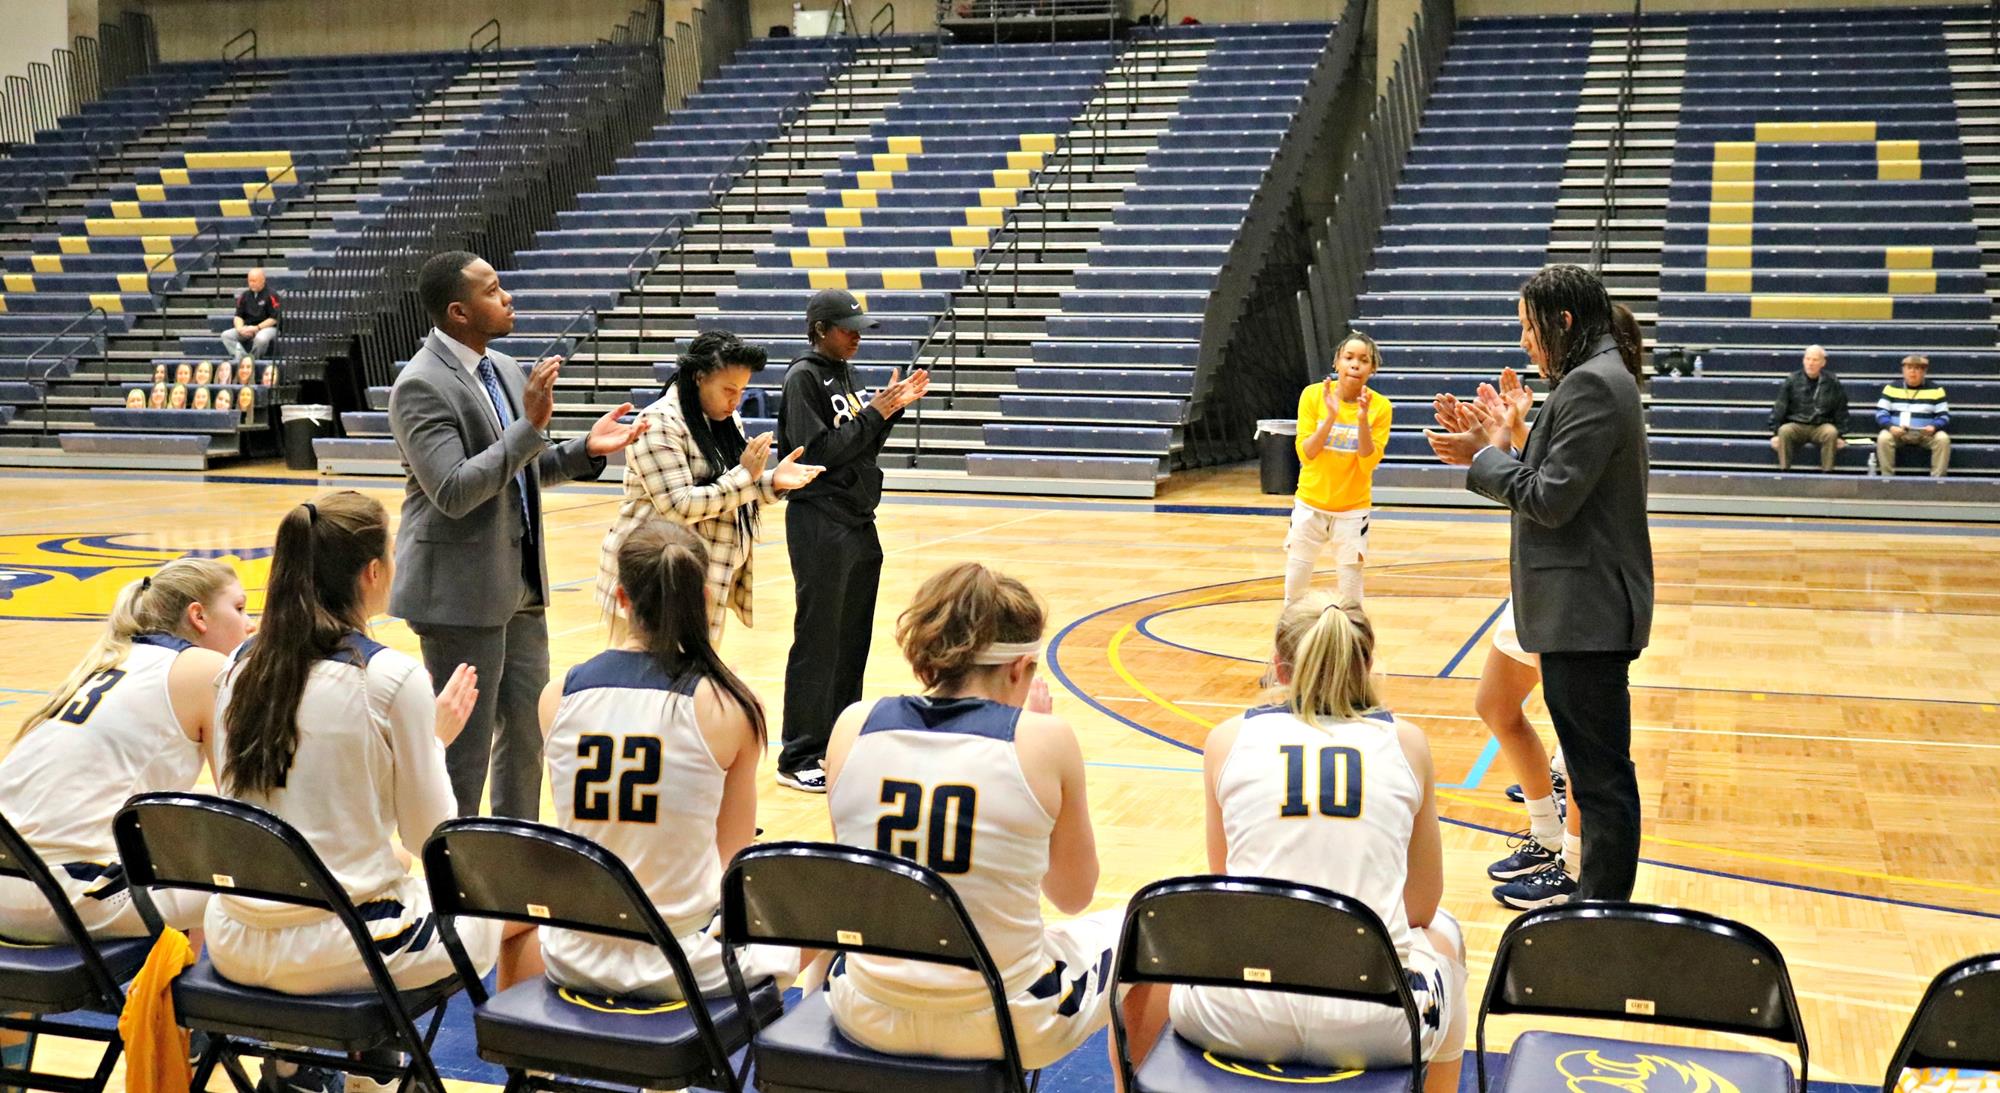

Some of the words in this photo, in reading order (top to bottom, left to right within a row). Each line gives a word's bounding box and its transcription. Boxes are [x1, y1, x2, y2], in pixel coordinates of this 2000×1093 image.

[47, 667, 127, 725] 3
[574, 733, 663, 825] 22
[1279, 744, 1364, 820] 10
[876, 777, 978, 875] 20
